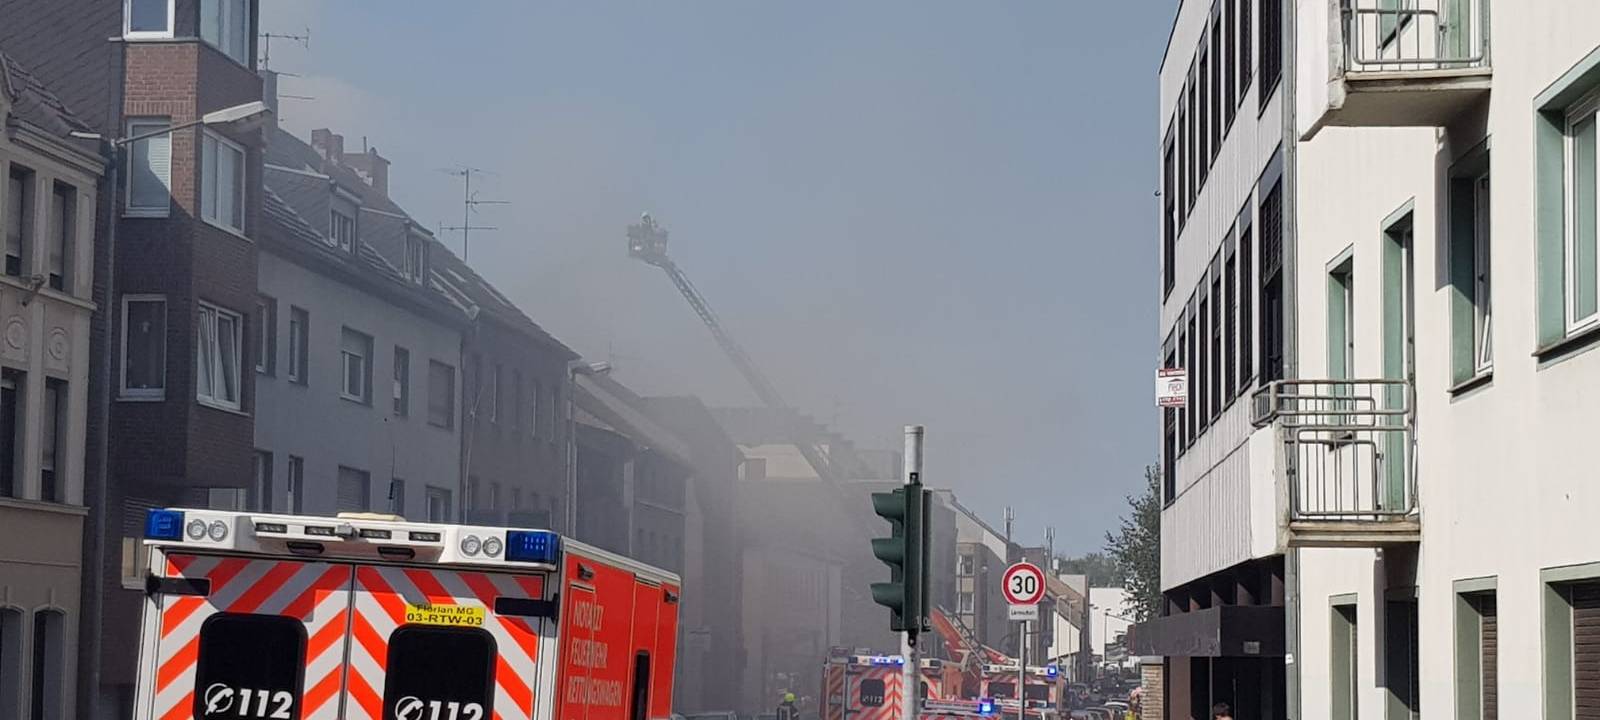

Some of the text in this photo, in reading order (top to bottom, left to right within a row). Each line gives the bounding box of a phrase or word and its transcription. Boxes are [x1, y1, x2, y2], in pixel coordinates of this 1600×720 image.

[1012, 575, 1036, 594] 30
[407, 612, 483, 625] 03-RTW-03
[416, 604, 474, 615] Florian MG
[239, 688, 293, 719] 112
[429, 700, 484, 720] 112
